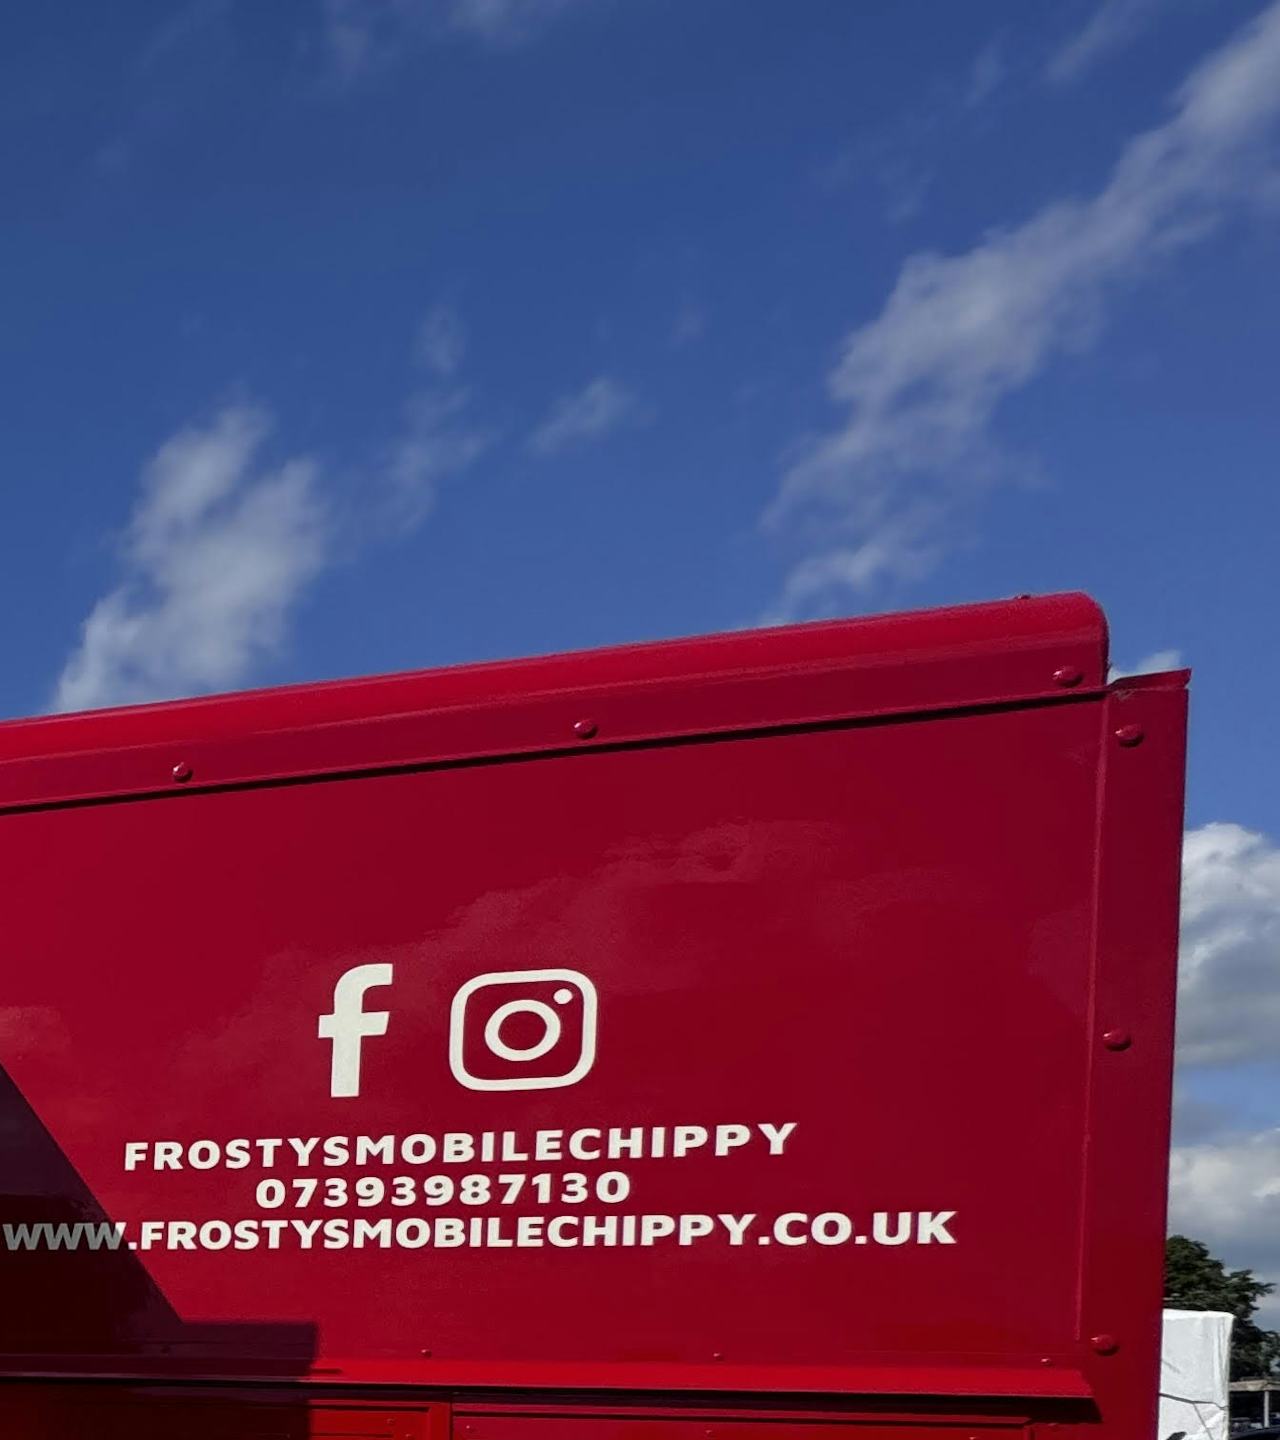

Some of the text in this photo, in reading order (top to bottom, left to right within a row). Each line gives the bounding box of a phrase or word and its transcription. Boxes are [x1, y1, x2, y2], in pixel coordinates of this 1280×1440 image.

[124, 1122, 798, 1171] FROSTYSMOBILECHIPPY
[255, 1171, 631, 1209] 07393987130
[2, 1210, 958, 1251] WWW.FROSTYSMOBILECHIPPY.CO.UK
